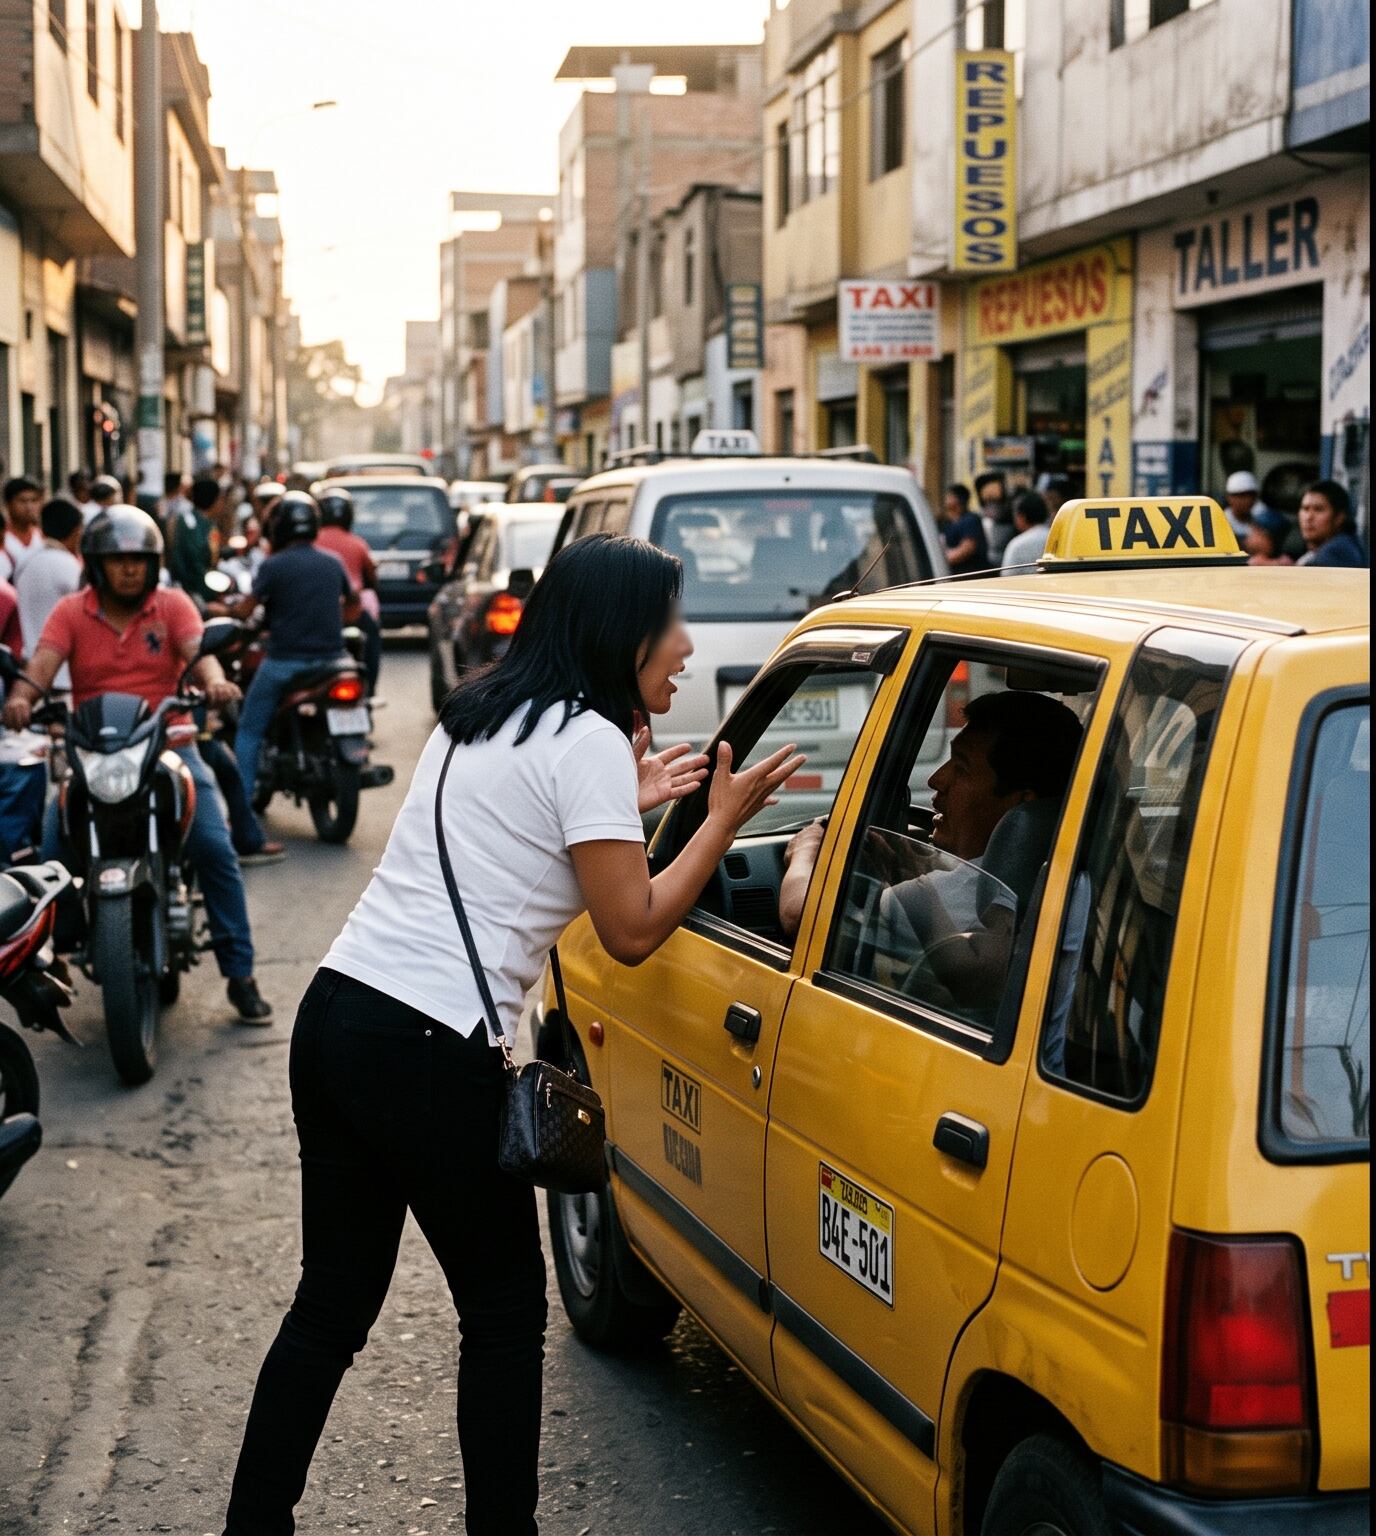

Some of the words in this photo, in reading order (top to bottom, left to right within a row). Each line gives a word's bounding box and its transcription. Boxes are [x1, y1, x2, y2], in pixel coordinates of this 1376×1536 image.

[962, 61, 1008, 265] REPUESOS
[1174, 196, 1321, 296] TALLER
[847, 285, 935, 311] TAXI
[979, 254, 1107, 338] REPUESOS
[708, 436, 751, 450] TAXI
[1085, 505, 1216, 551] TAXI
[663, 1066, 699, 1129] TAXI
[822, 1192, 891, 1295] B4E-501
